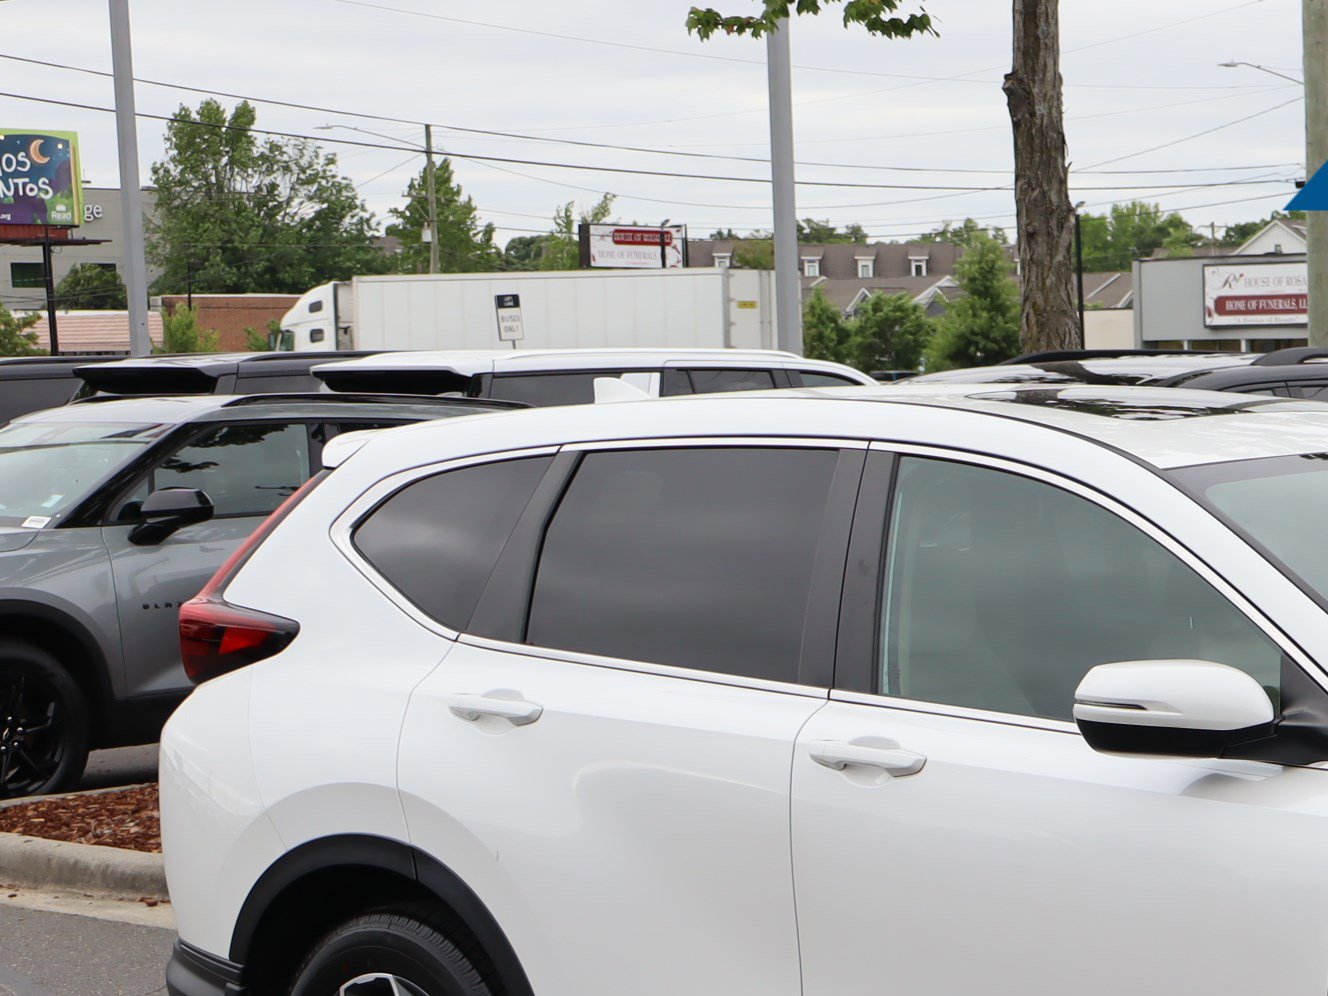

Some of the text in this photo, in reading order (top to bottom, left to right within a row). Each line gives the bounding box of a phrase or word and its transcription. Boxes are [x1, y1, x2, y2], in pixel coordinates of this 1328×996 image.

[0, 151, 31, 177] OS
[51, 211, 72, 219] Read
[1244, 275, 1272, 288] HOUSE
[1273, 275, 1284, 287] OF
[1225, 300, 1246, 311] HOME
[1247, 300, 1257, 310] OF
